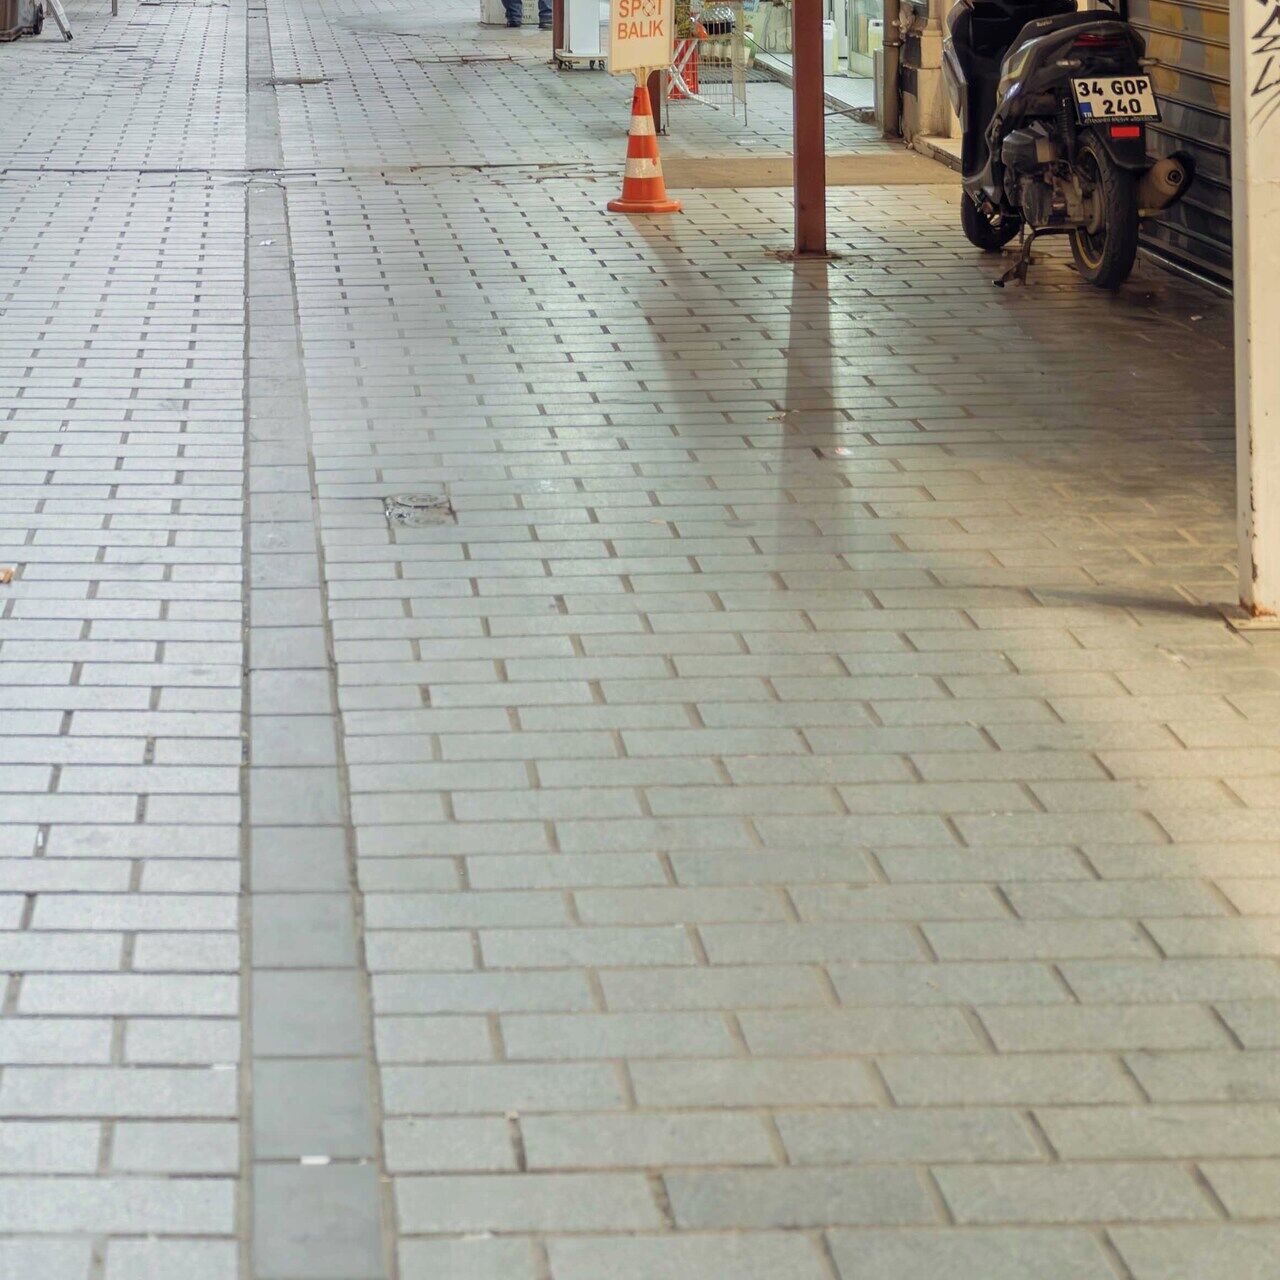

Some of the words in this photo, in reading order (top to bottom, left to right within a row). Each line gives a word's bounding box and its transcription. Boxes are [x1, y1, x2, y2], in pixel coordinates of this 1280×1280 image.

[617, 20, 664, 40] BALIK
[1077, 81, 1104, 97] 34
[1111, 79, 1148, 96] GOP
[1102, 98, 1142, 115] 240
